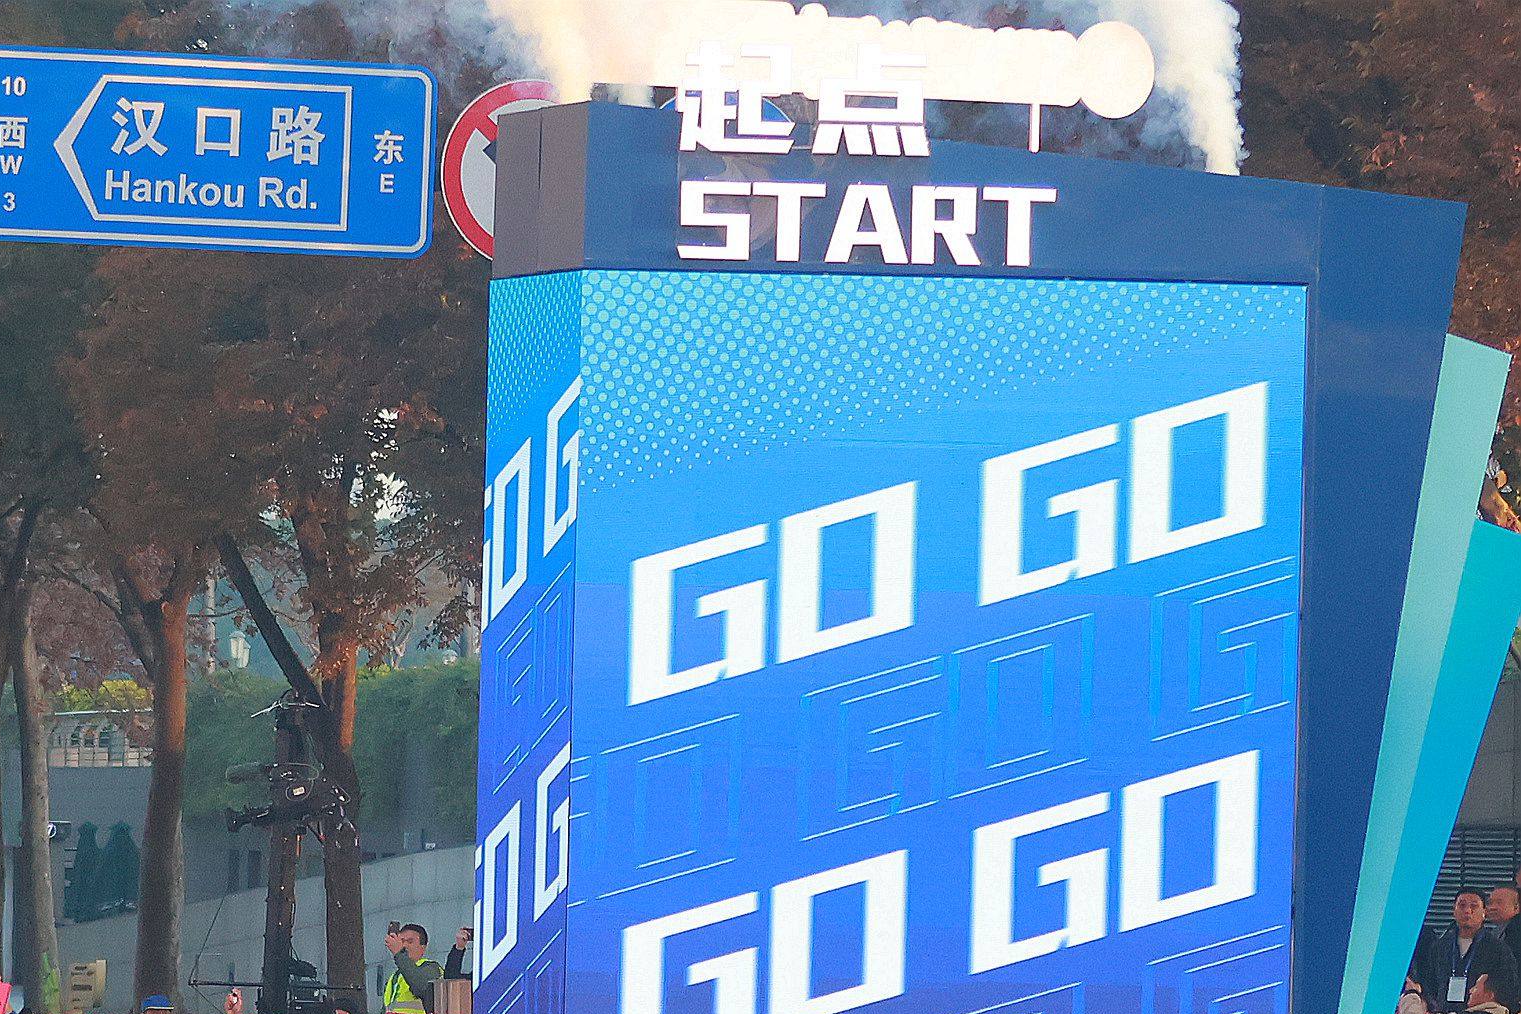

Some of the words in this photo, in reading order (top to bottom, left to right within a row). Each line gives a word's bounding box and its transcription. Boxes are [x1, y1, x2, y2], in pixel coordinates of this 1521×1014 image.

[1, 75, 27, 98] 10
[679, 41, 931, 157] 起点
[110, 97, 327, 166] 汉口路
[372, 129, 405, 165] 东
[0, 155, 23, 176] W
[379, 173, 395, 195] E
[2, 192, 17, 213] 3
[104, 169, 246, 209] Hankou
[257, 176, 320, 211] Rd.
[677, 180, 1059, 268] START
[627, 480, 921, 707] GO
[979, 380, 1270, 607] GO
[969, 748, 1262, 975] GO
